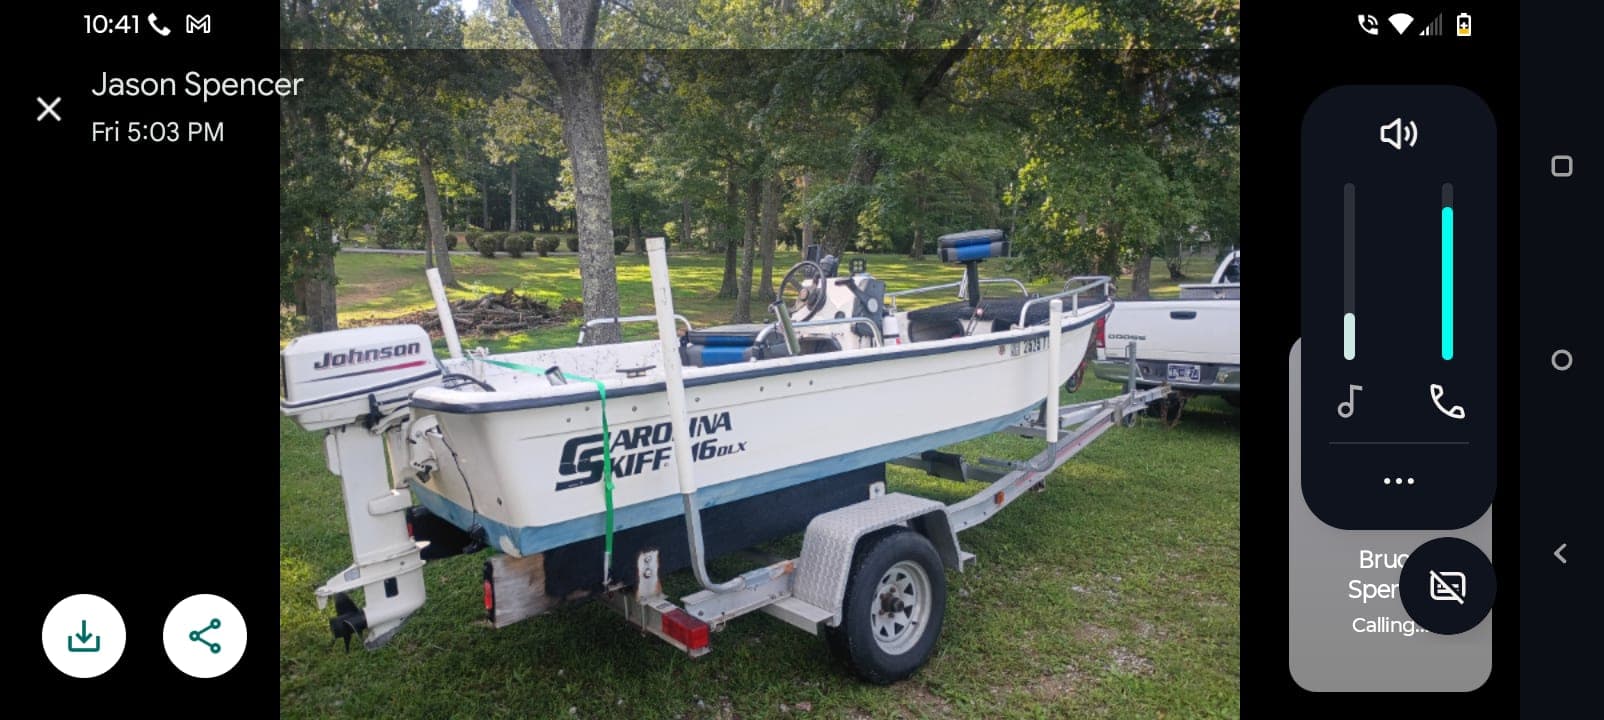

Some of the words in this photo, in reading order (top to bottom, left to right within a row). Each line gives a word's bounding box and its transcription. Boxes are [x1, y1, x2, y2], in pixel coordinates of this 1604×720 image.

[313, 342, 420, 369] Johnson
[558, 411, 732, 476] CAROINA
[554, 446, 672, 492] SKIFF
